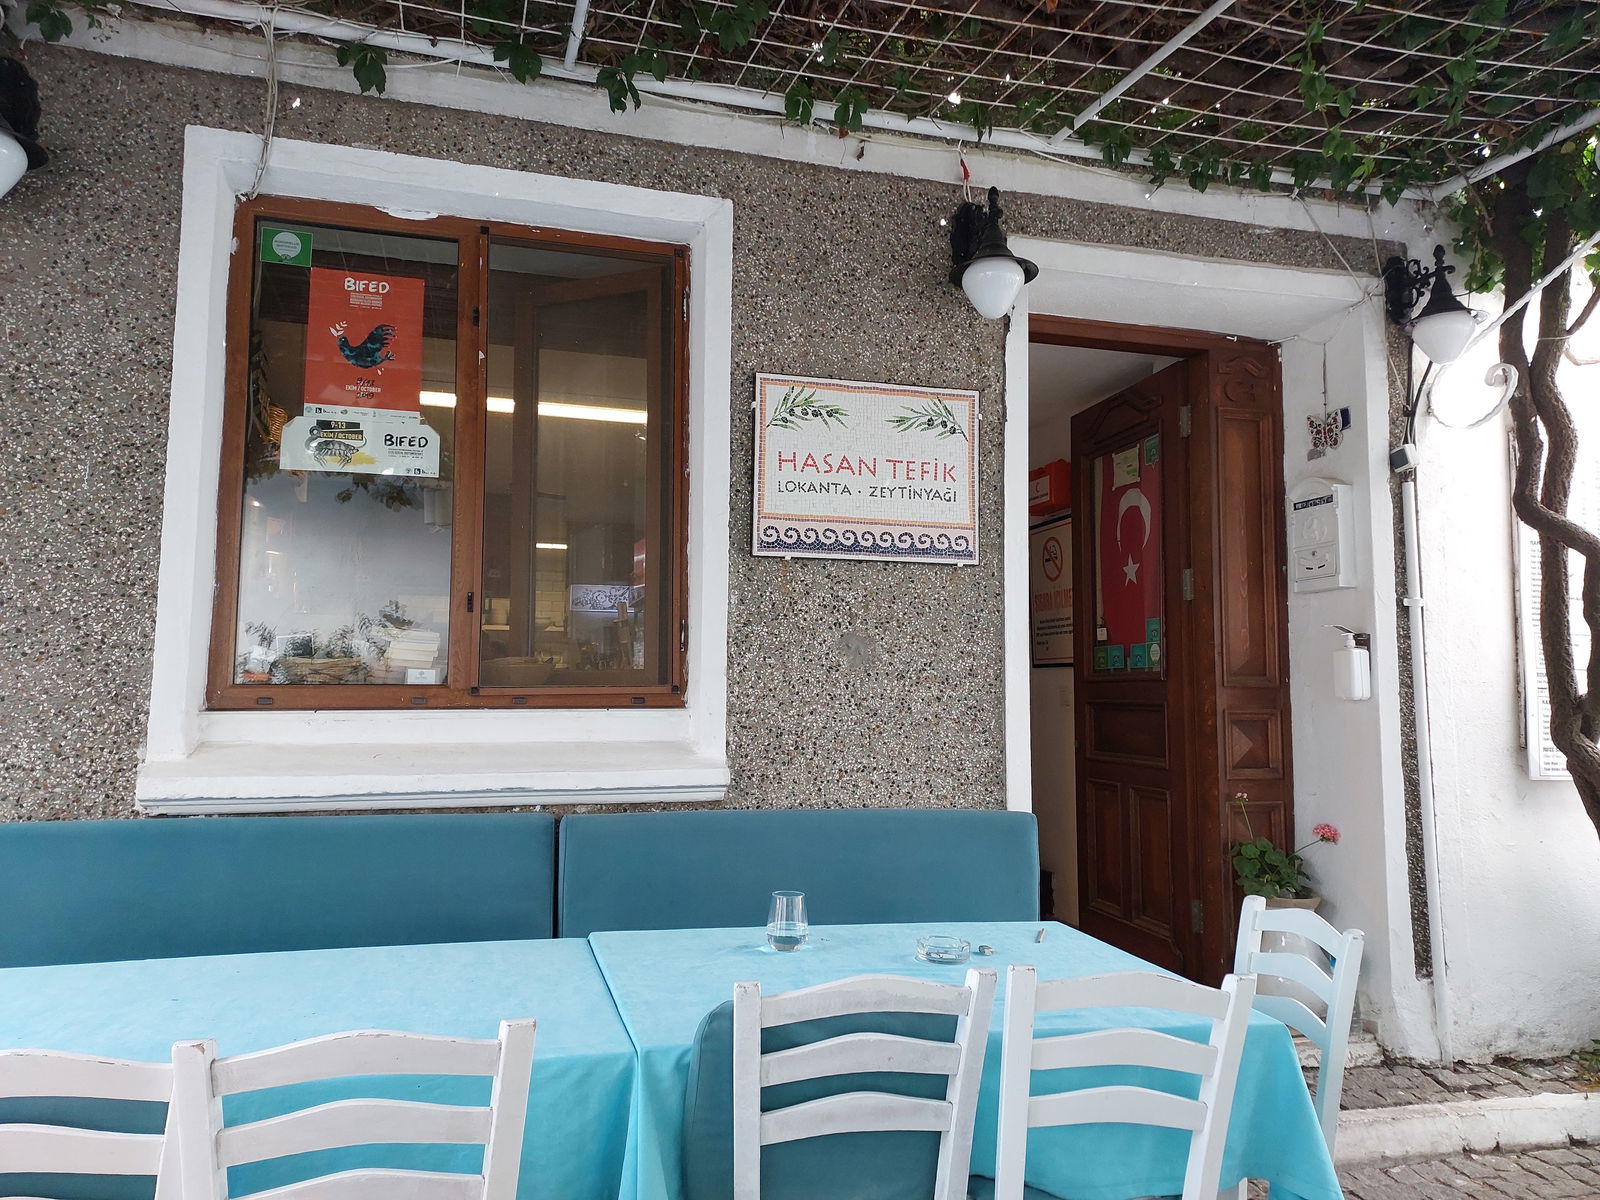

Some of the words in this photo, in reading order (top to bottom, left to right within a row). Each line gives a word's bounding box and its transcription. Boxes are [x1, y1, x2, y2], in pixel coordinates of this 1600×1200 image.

[344, 277, 390, 294] BIFED
[330, 421, 347, 429] 9-13
[338, 432, 362, 440] OCTOBER
[384, 433, 429, 448] BIFED
[778, 451, 877, 478] HASAN
[885, 458, 957, 483] TEFİK
[777, 480, 852, 496] LOKANTA
[869, 485, 957, 503] ZEYTİNYAĞI
